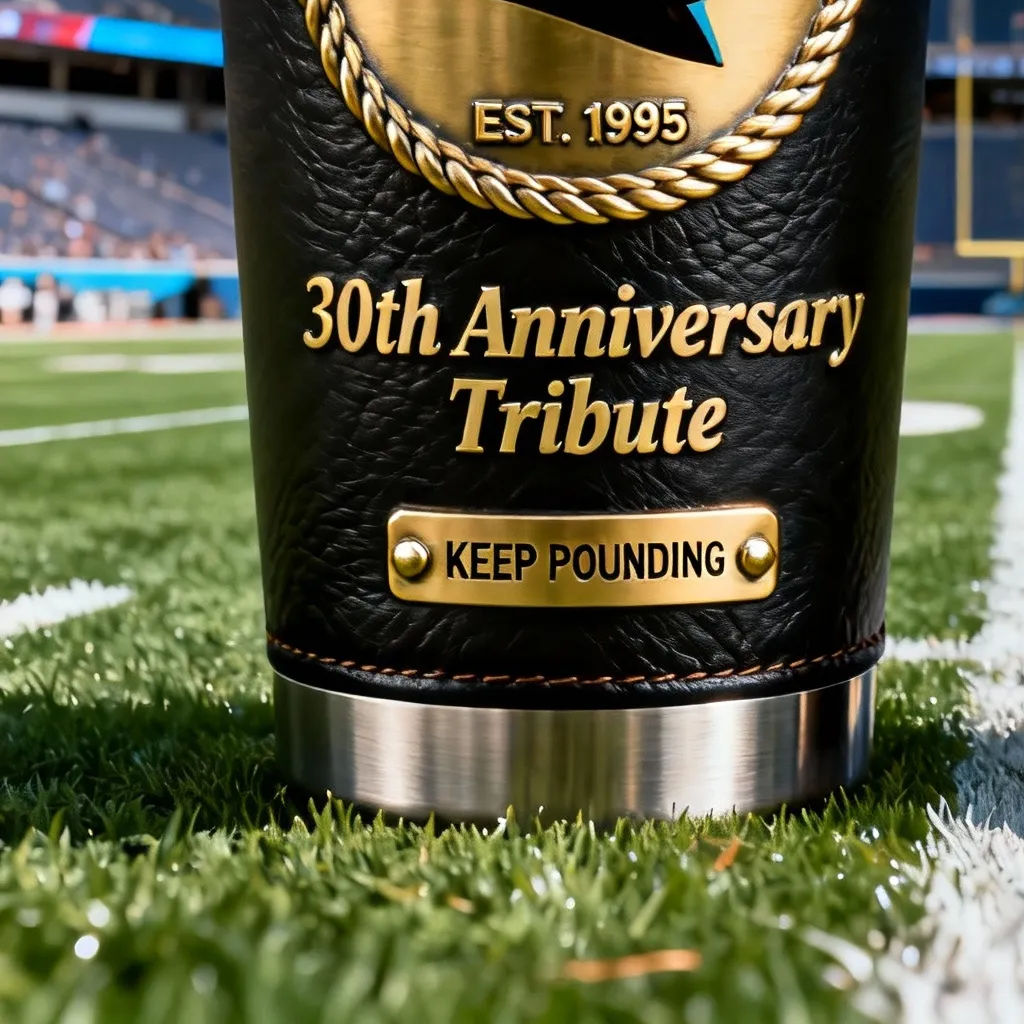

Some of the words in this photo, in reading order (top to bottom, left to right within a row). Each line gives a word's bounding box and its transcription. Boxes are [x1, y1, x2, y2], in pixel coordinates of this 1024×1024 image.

[474, 101, 571, 144] EST.
[585, 100, 688, 144] 1995
[303, 276, 441, 356] 30th
[449, 284, 865, 368] Anniversary
[449, 375, 728, 455] Tribute
[446, 541, 537, 581] KEEP
[549, 540, 725, 581] POUNDING
